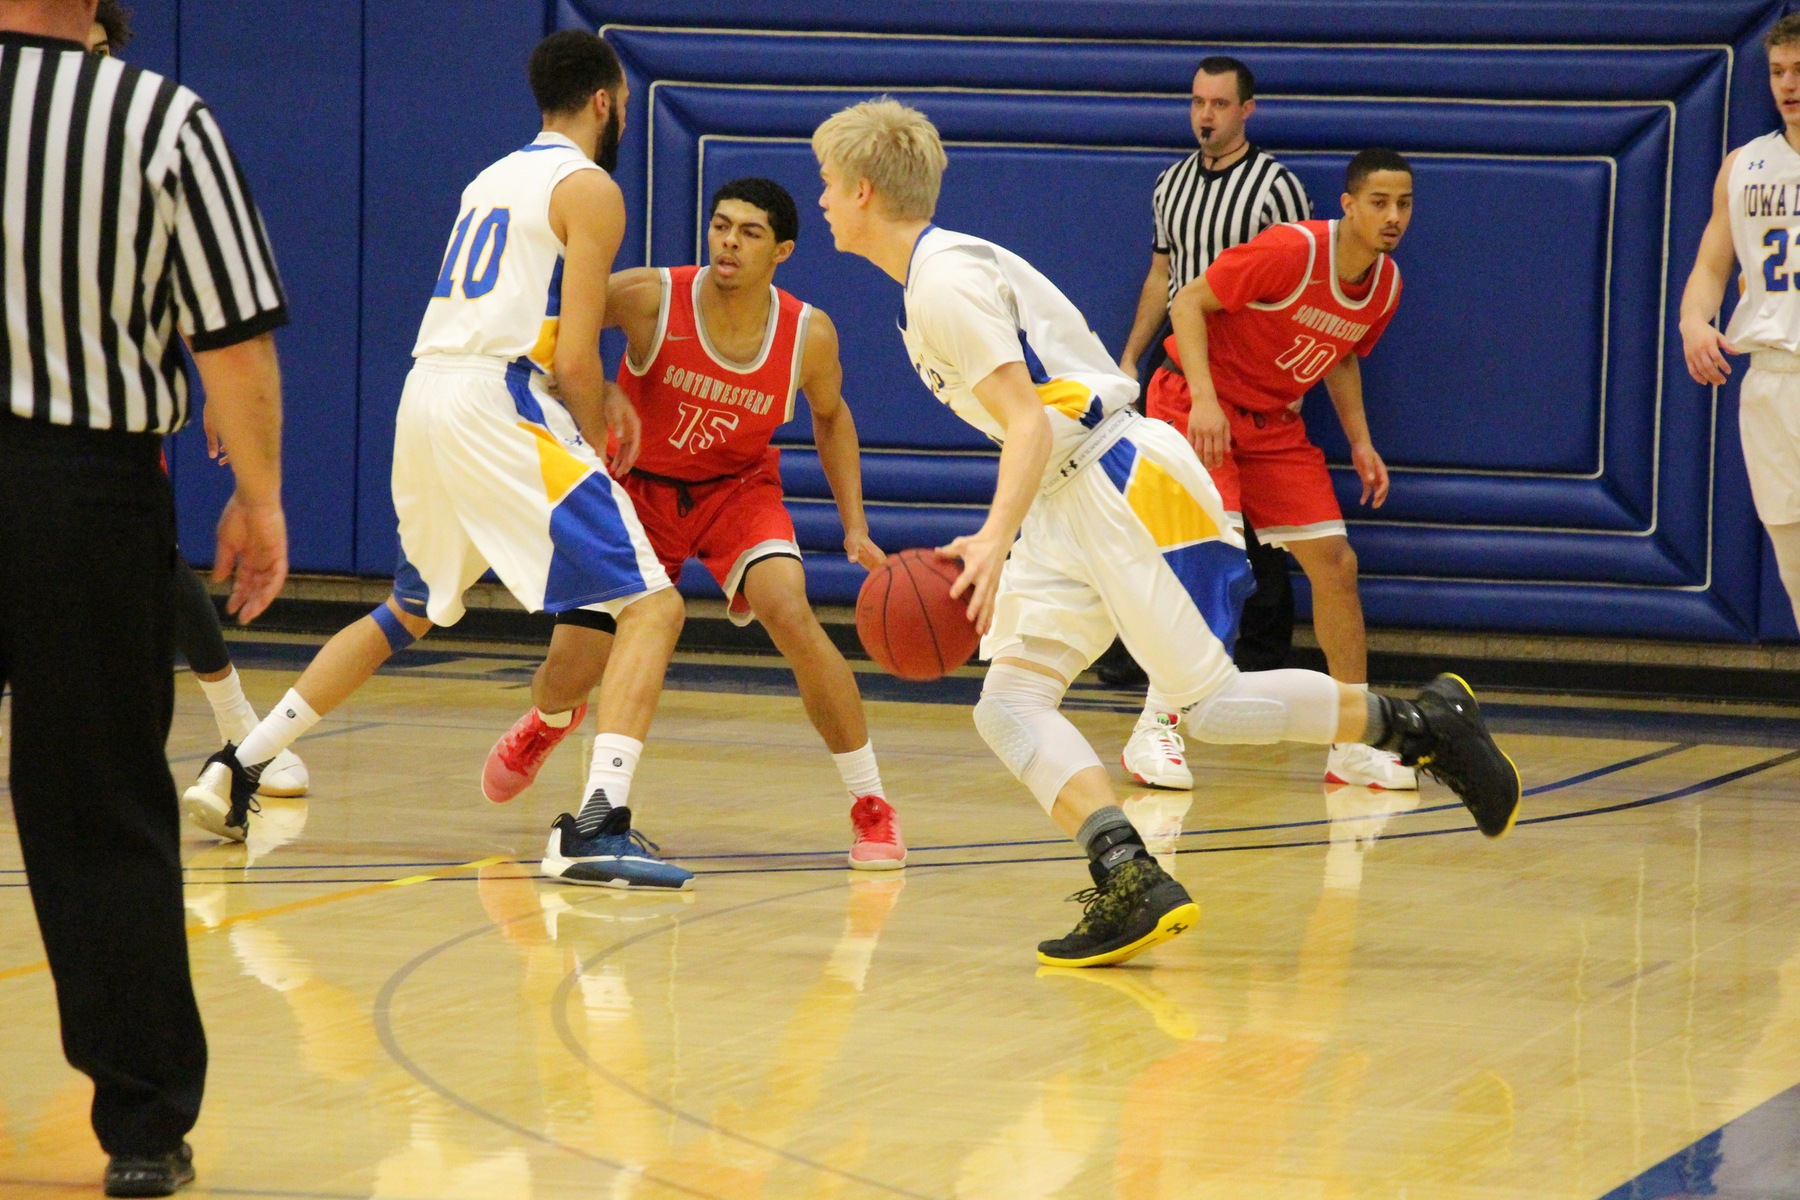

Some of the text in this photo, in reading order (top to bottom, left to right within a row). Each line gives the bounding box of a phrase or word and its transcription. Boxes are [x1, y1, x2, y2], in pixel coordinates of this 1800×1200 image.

[1744, 183, 1786, 217] IOWA
[431, 205, 511, 301] 10
[1274, 333, 1337, 383] 10
[662, 364, 775, 416] SOUTHWESTERN
[667, 401, 740, 455] 15
